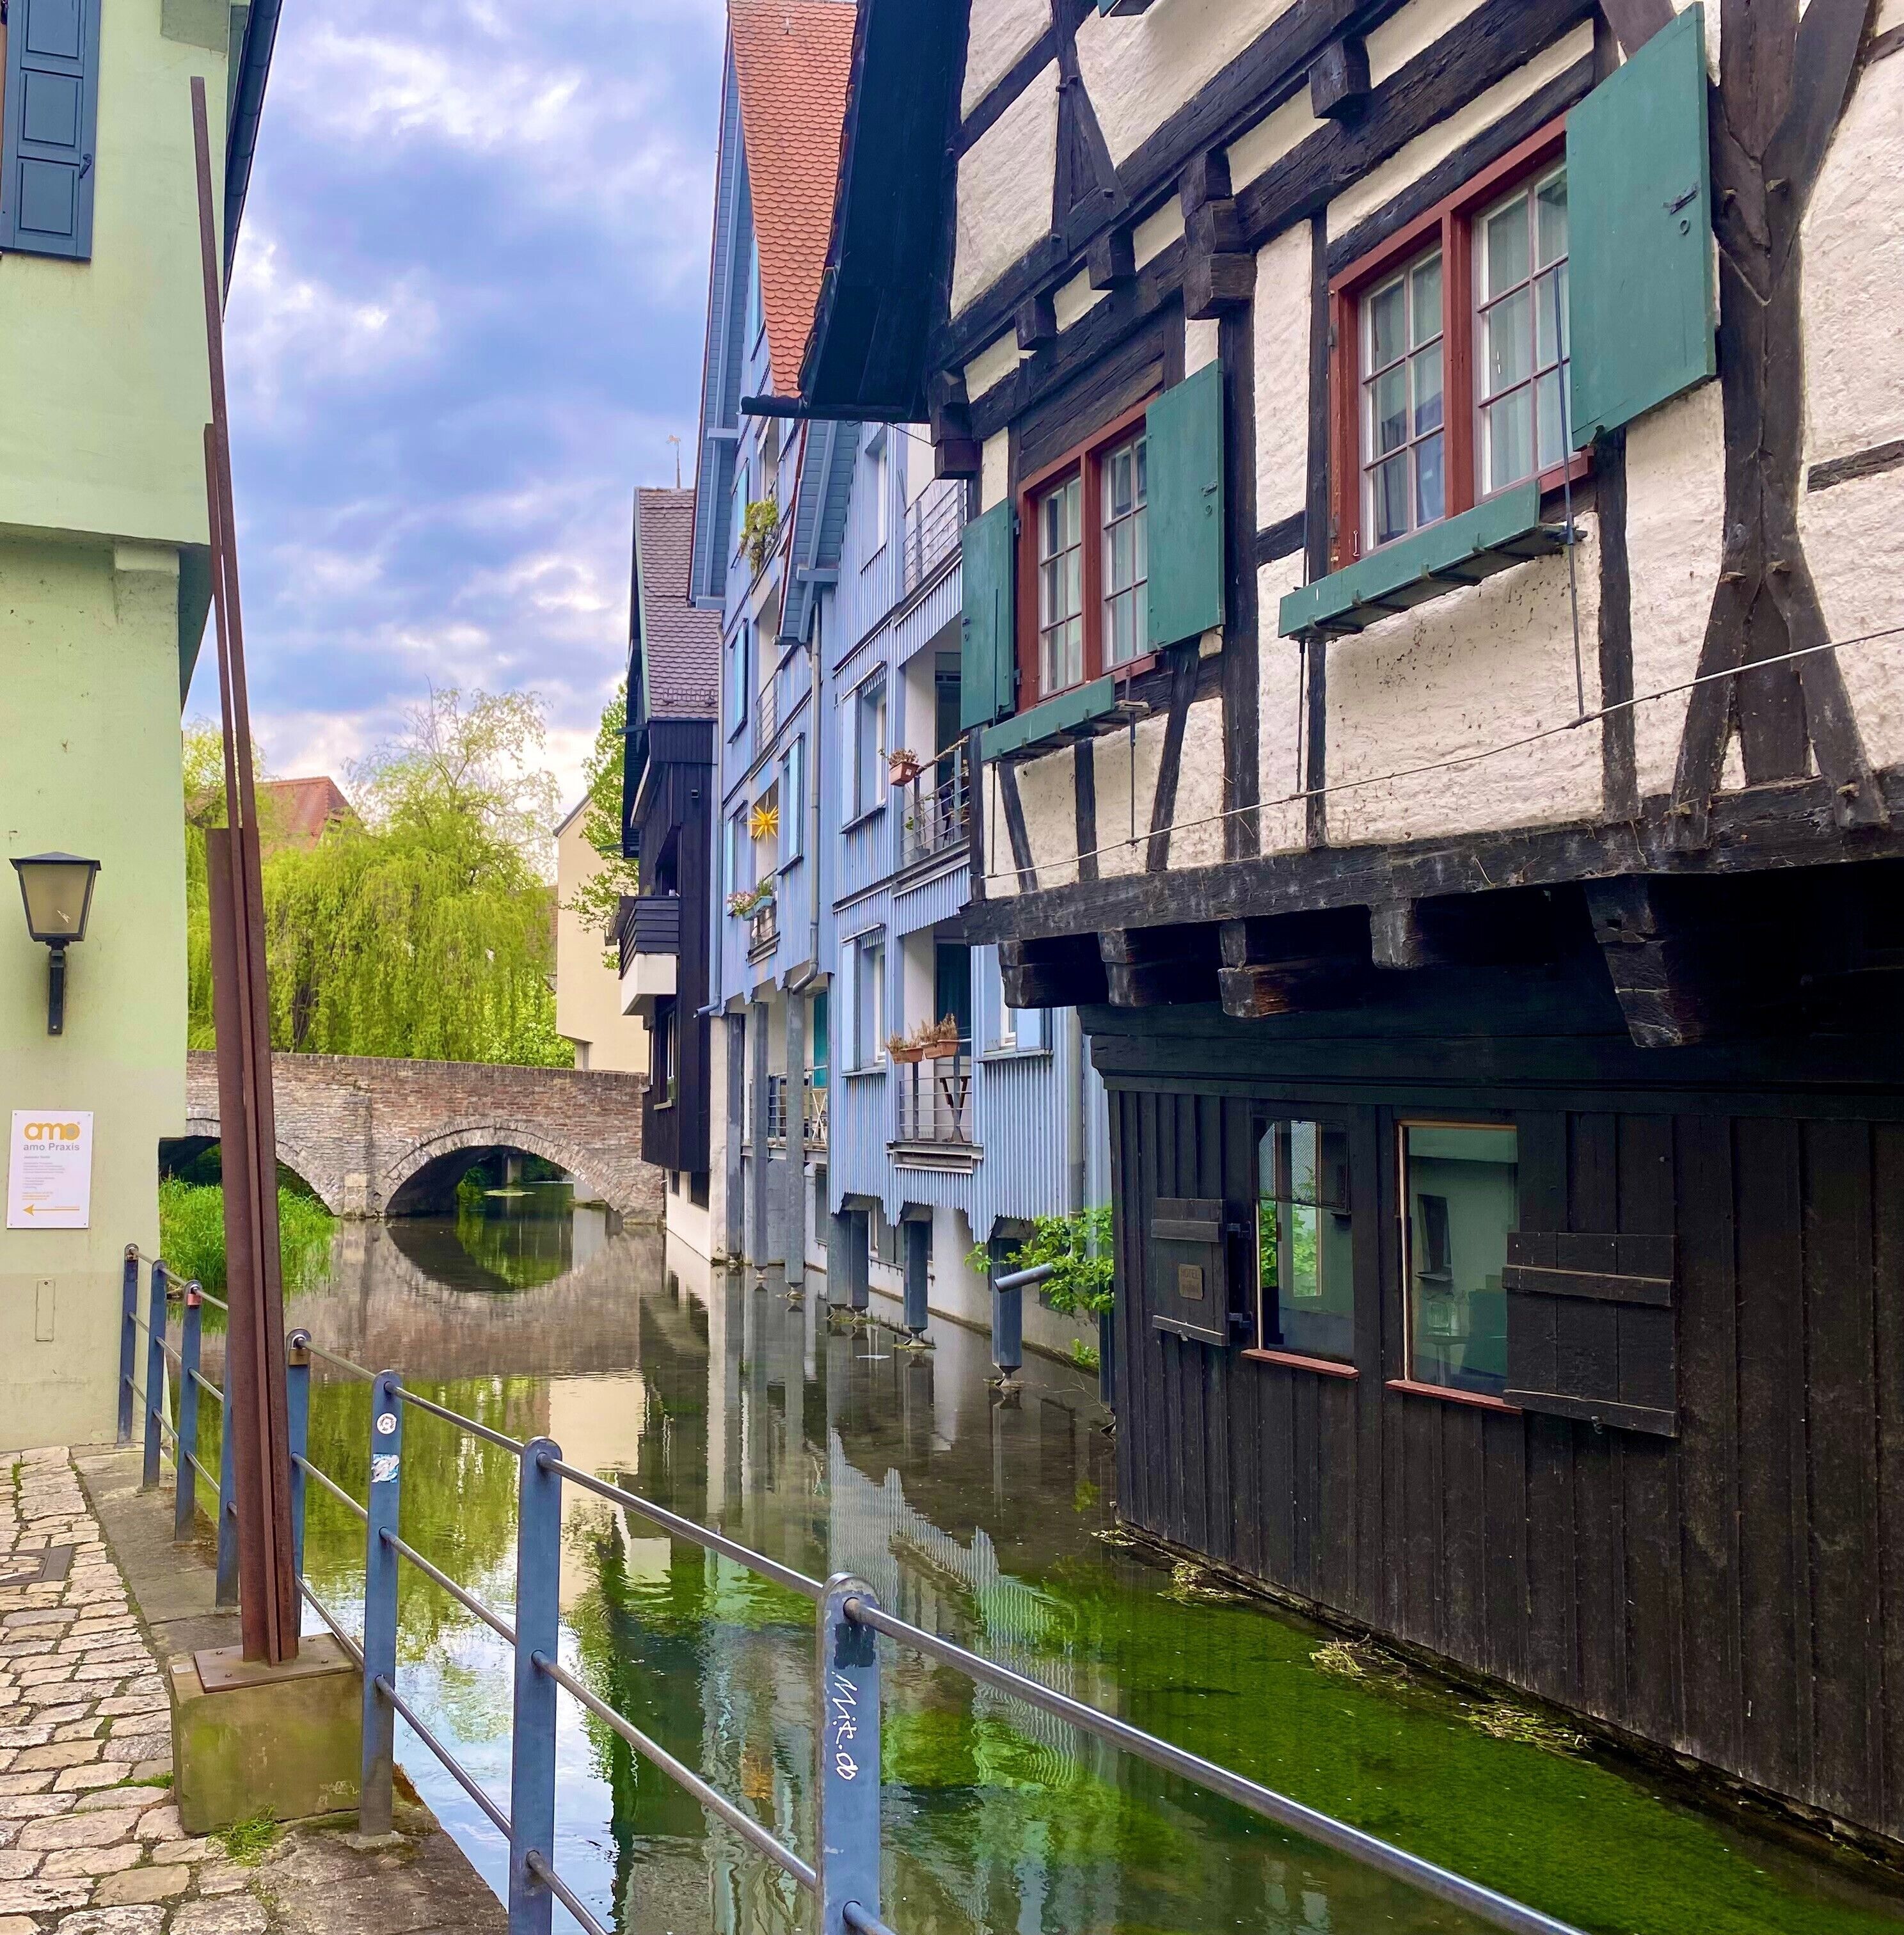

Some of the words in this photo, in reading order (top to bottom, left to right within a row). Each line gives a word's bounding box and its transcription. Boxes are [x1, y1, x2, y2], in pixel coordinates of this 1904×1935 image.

[24, 1123, 80, 1140] amo
[49, 1142, 80, 1151] Praxis
[1181, 1268, 1199, 1279] HOTEL
